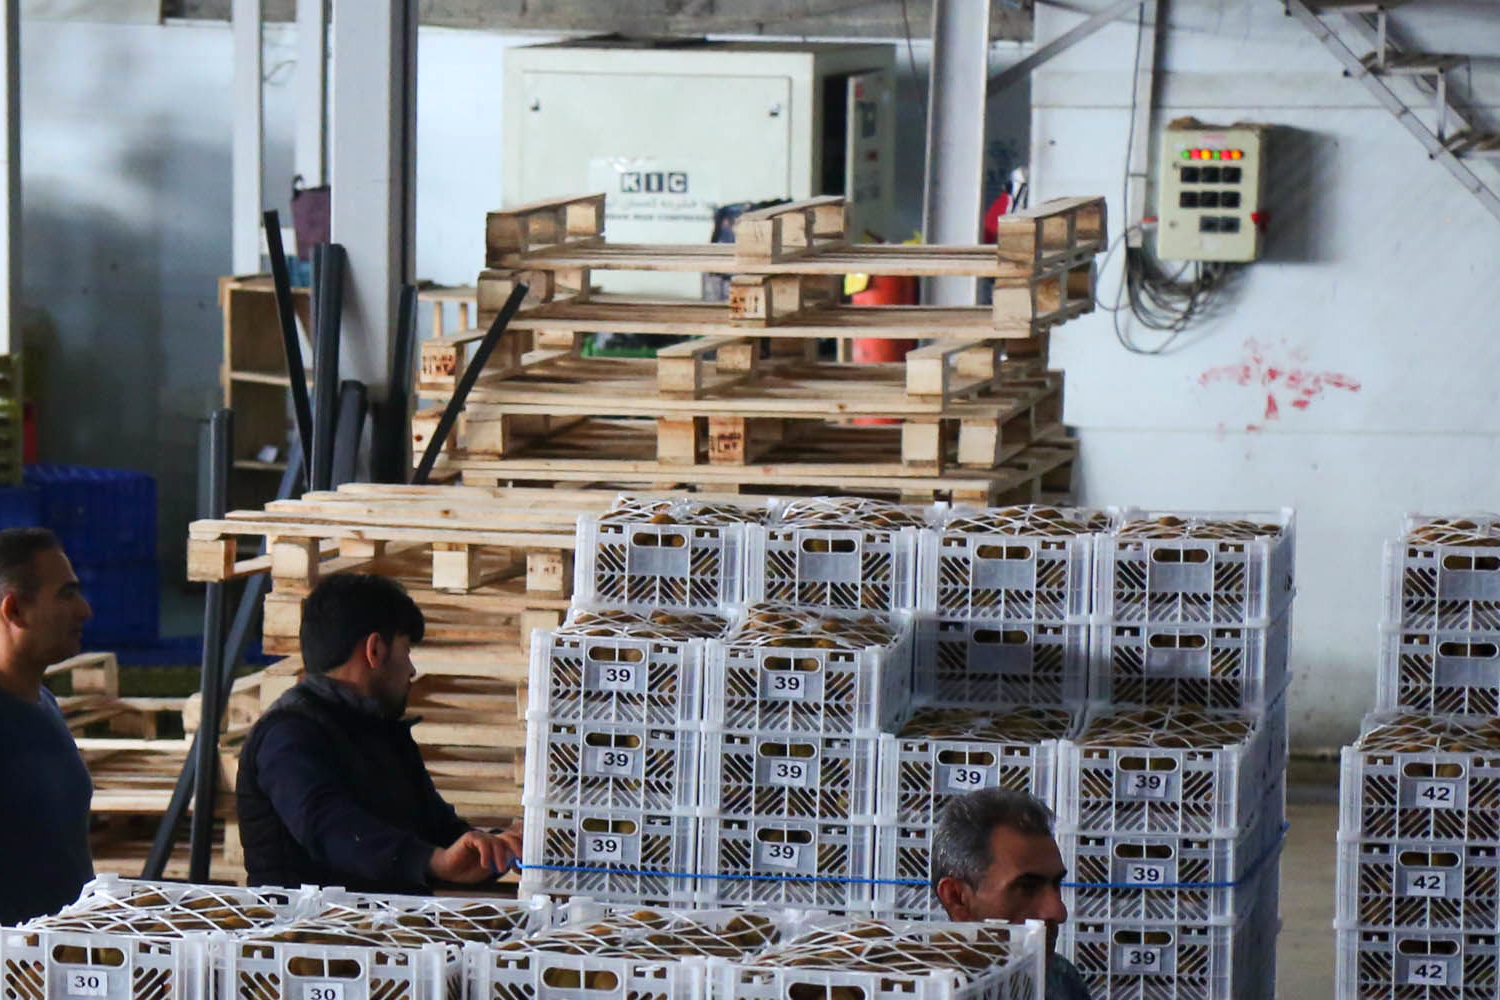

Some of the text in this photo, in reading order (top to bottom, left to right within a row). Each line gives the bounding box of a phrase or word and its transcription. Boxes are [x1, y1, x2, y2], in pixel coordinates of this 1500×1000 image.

[606, 667, 630, 682] 39
[774, 675, 799, 690] 39
[604, 751, 628, 767] 39
[777, 763, 802, 779] 39
[956, 767, 981, 784] 39
[1135, 773, 1161, 790] 39
[1422, 785, 1450, 801] 42
[593, 838, 617, 853] 39
[769, 843, 794, 859] 39
[1133, 866, 1159, 882] 39
[1413, 874, 1440, 890] 42
[1130, 950, 1155, 965] 39
[1414, 963, 1442, 979] 42
[75, 975, 99, 988] 30
[311, 987, 336, 1000] 30
